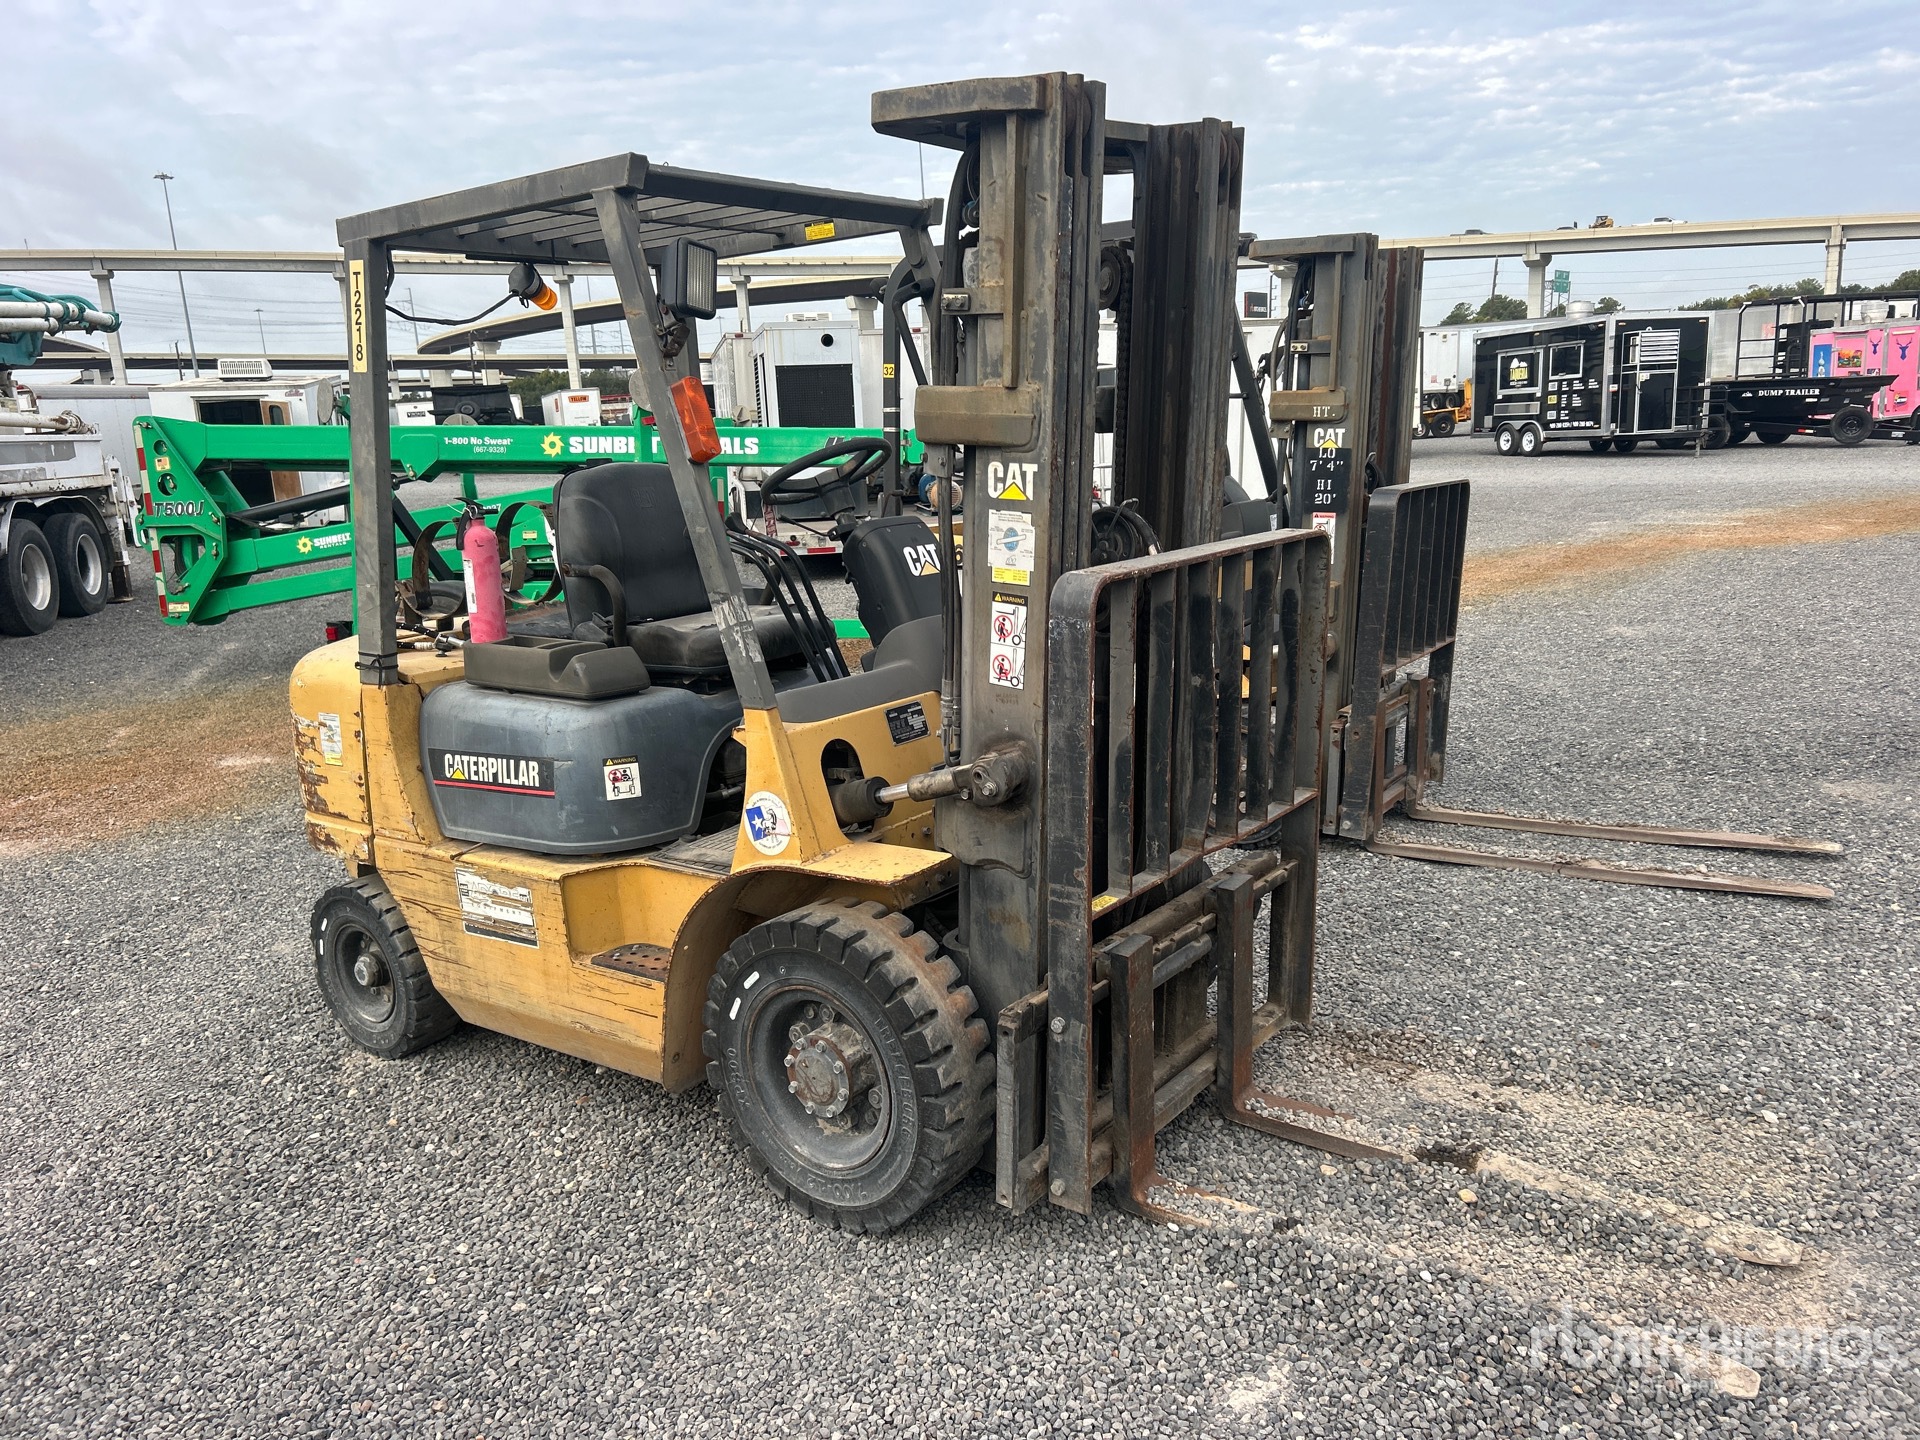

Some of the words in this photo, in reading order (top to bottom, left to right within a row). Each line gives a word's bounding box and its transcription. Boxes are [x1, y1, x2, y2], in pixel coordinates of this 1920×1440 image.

[353, 271, 364, 362] T2218
[883, 366, 894, 376] 32
[1785, 388, 1820, 396] TRAILER
[1313, 406, 1336, 418] HT.
[443, 436, 469, 445] 1-800
[470, 436, 482, 445] No
[1314, 427, 1346, 448] CAT
[1319, 447, 1336, 459] LO
[987, 461, 1038, 501] CAT
[1316, 479, 1332, 490] HI
[154, 500, 205, 518] T500J
[313, 532, 352, 547] SUNBELT
[903, 543, 941, 577] CAT
[1001, 595, 1025, 605] WARNING
[613, 756, 637, 764] WARNING
[444, 753, 540, 787] CATERPILLAR
